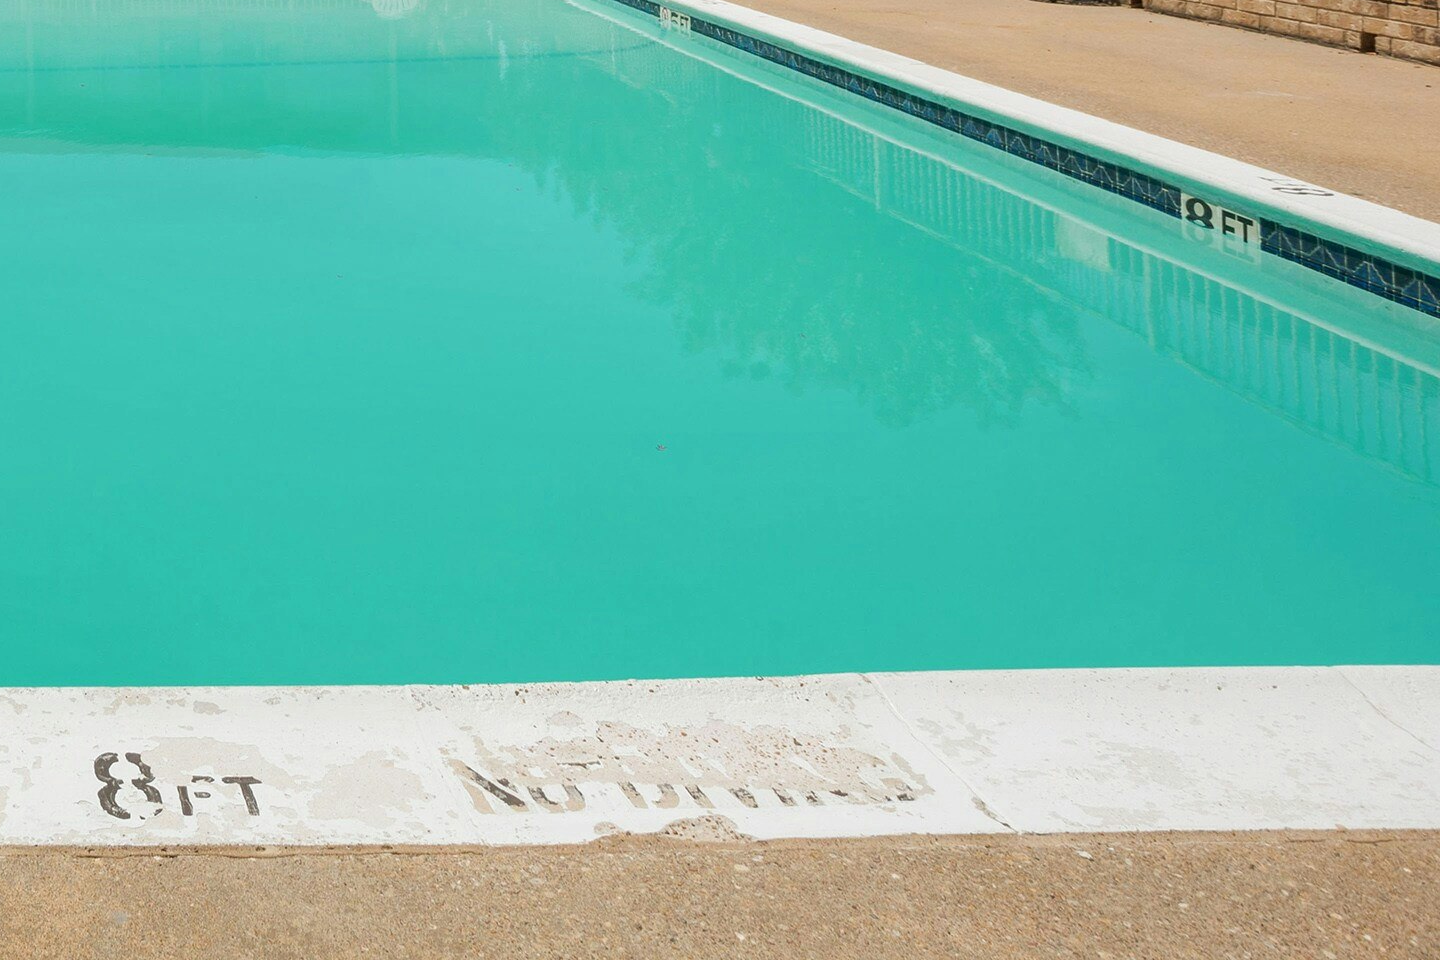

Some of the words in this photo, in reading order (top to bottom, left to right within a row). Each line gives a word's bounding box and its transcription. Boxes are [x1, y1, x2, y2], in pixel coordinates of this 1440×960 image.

[1186, 198, 1215, 230] 8
[1222, 209, 1254, 244] FT
[94, 752, 163, 820] 8
[177, 776, 262, 816] FT
